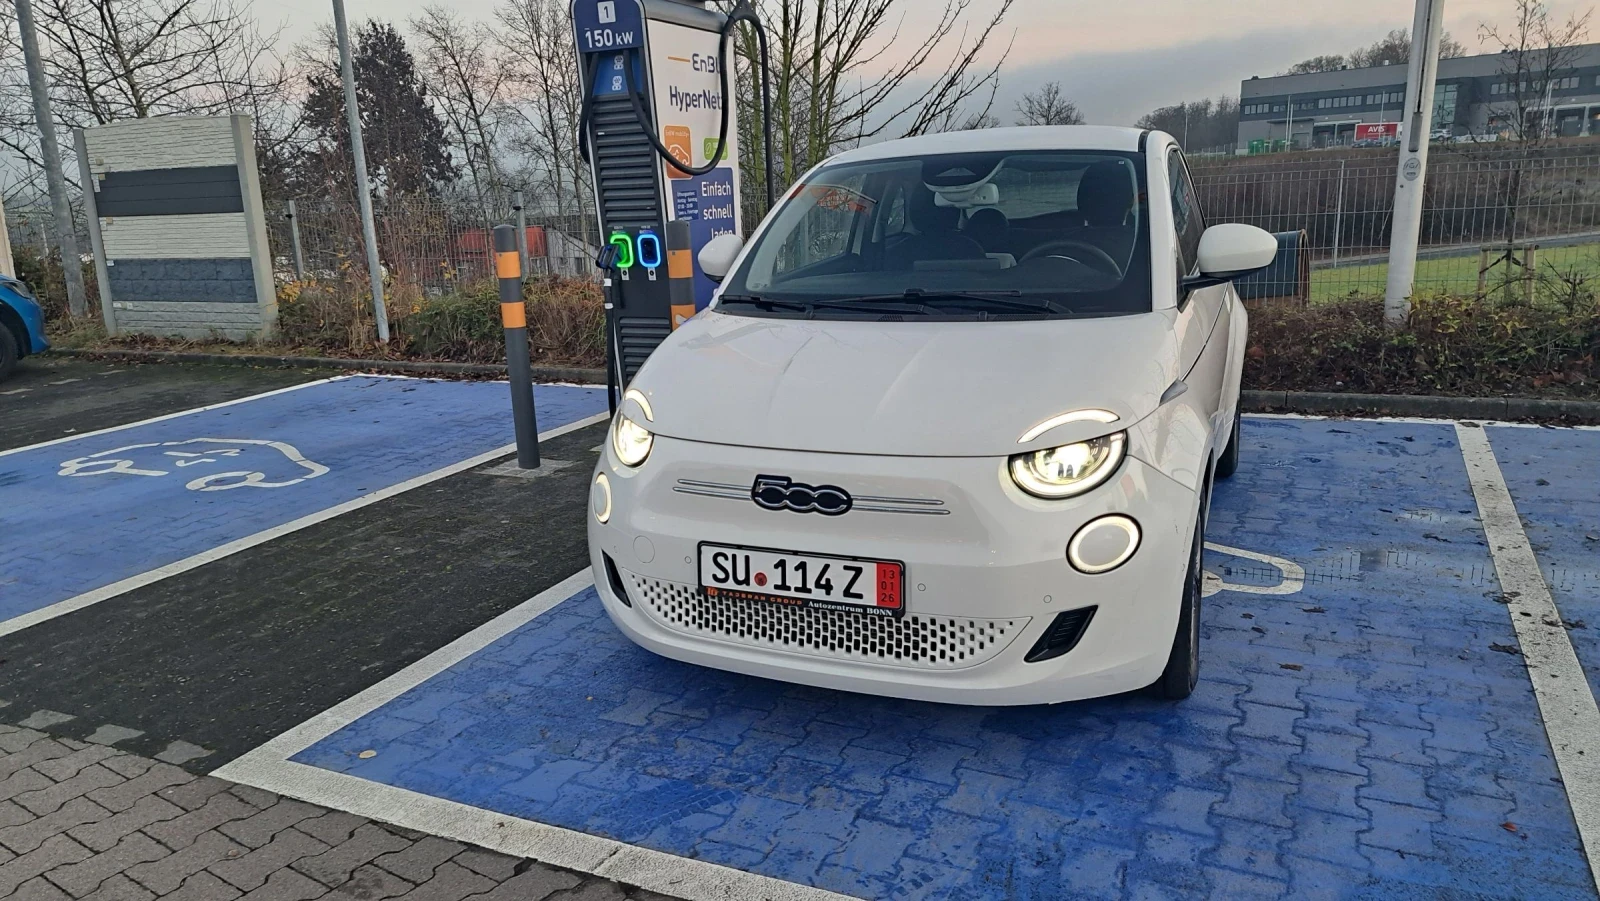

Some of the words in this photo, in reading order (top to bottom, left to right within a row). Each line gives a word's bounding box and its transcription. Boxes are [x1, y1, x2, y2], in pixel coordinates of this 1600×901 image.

[603, 5, 609, 19] 1
[585, 29, 613, 48] 150
[615, 31, 633, 45] kW
[669, 85, 722, 112] HyperNet
[701, 181, 731, 196] Einfach
[703, 203, 732, 220] schnell
[752, 475, 851, 515] 500
[711, 552, 750, 586] SU
[881, 569, 895, 580] 13
[880, 580, 895, 591] 01
[880, 592, 895, 603] 26
[808, 600, 864, 613] Autozentrum
[866, 607, 893, 617] BONN
